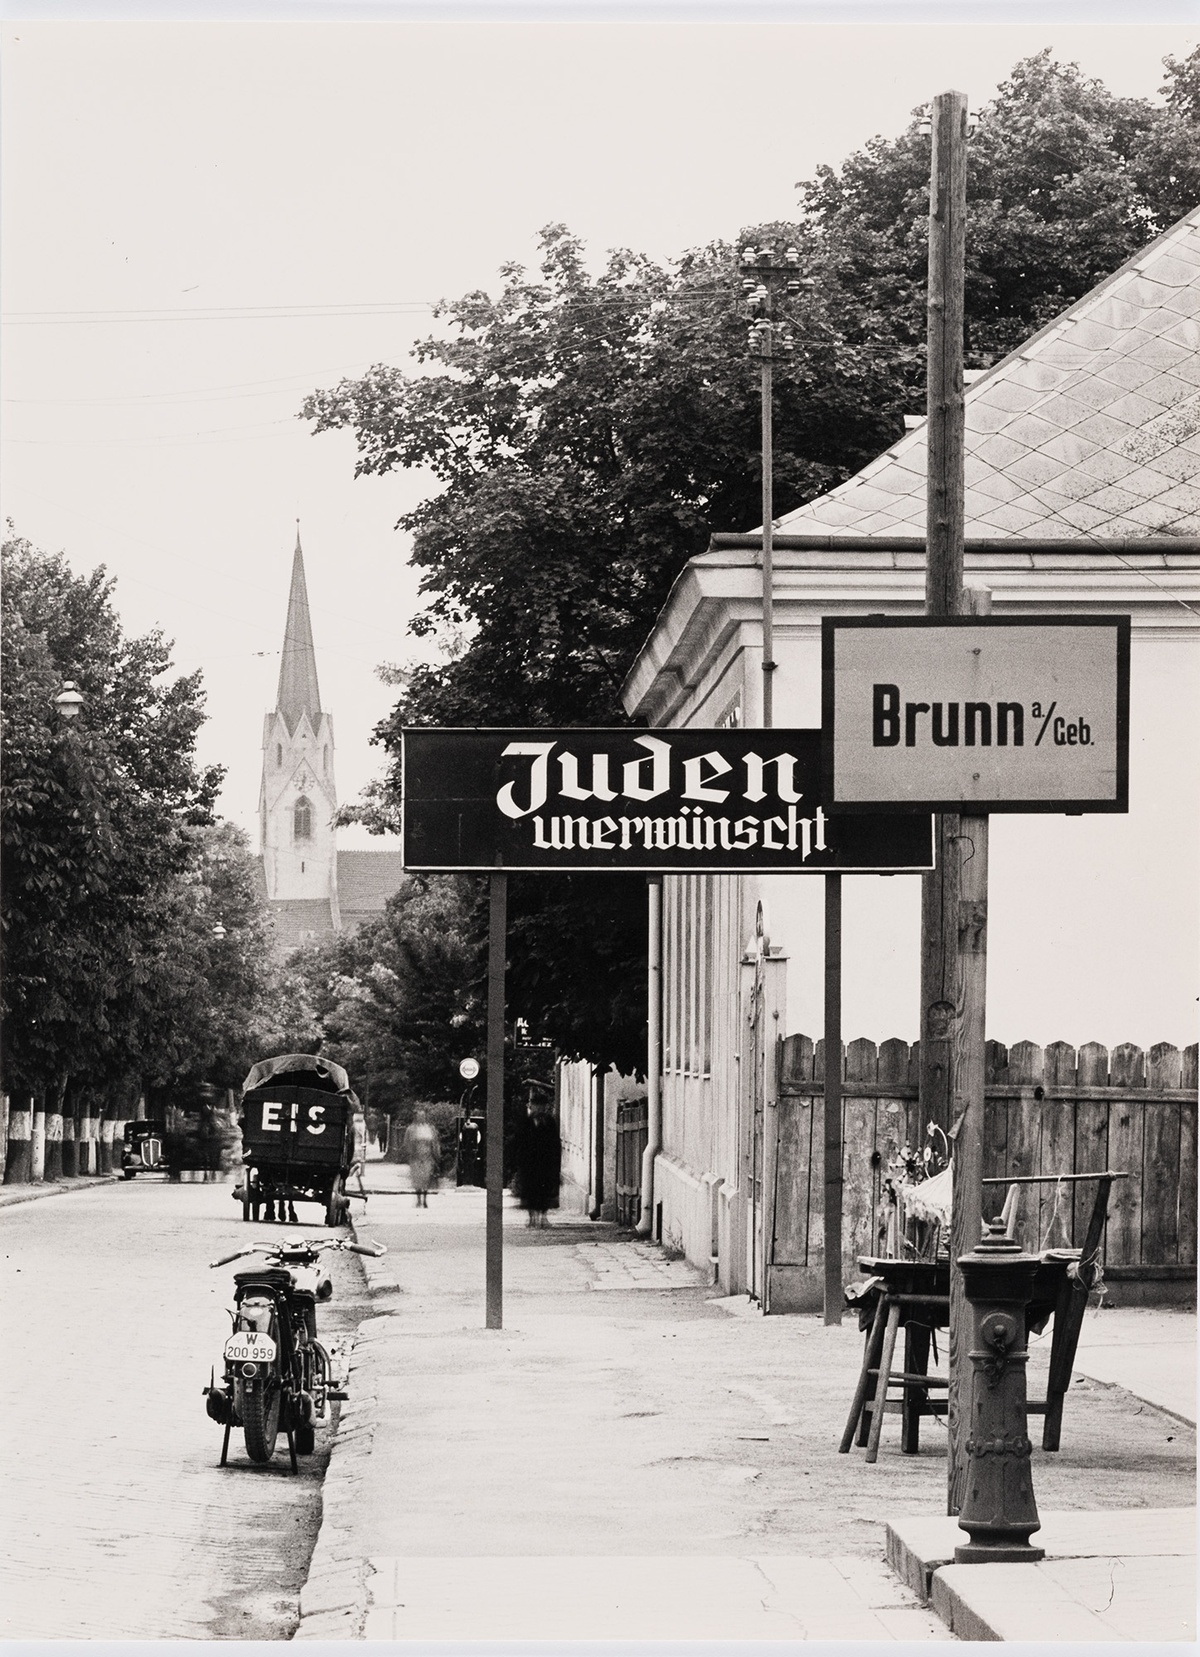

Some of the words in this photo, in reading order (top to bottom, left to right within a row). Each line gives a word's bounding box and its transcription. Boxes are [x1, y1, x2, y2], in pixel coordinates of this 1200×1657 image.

[872, 683, 1024, 747] Brunn
[496, 734, 804, 819] Juden
[532, 805, 829, 862] unerwünscht
[261, 1101, 327, 1135] EIS
[227, 1346, 248, 1358] 200
[252, 1347, 274, 1360] 959
[246, 1333, 258, 1345] W
